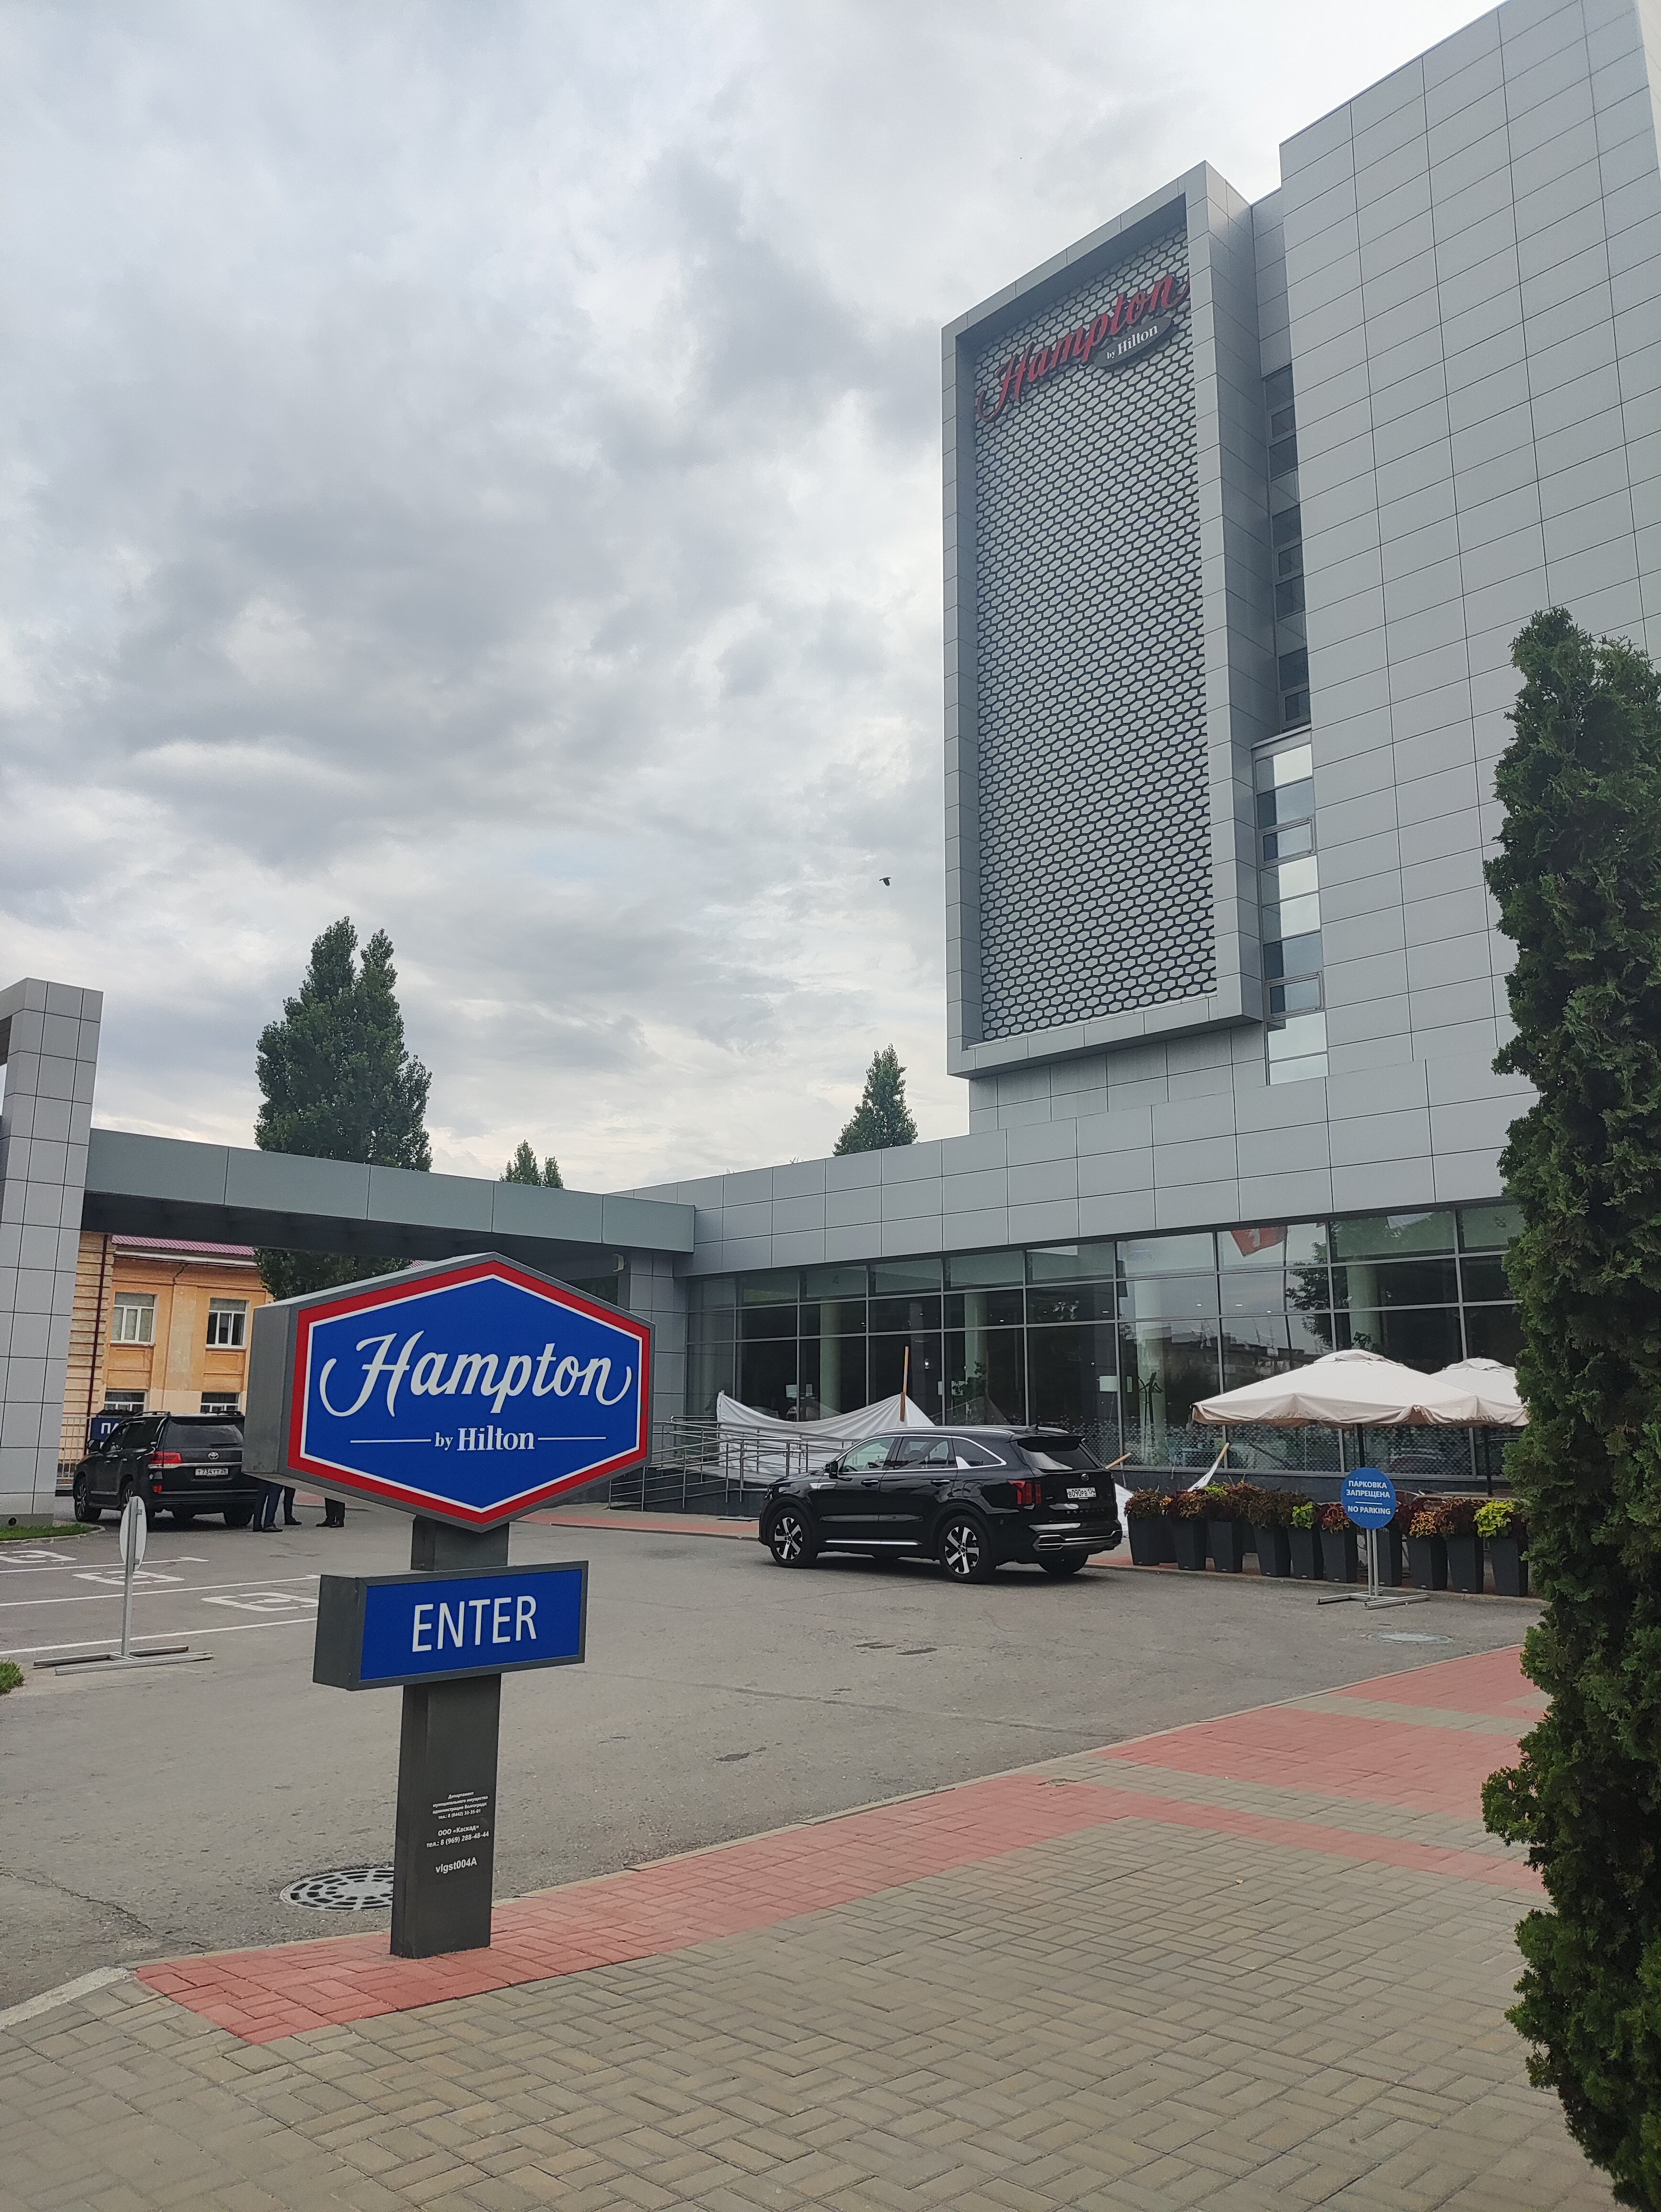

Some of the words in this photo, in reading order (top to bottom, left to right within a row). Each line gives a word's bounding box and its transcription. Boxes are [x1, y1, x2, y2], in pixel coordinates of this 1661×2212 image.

[977, 268, 1190, 423] Hampton
[1106, 351, 1116, 360] by
[1117, 324, 1159, 356] Hilton
[319, 1330, 632, 1417] Hampton
[434, 1431, 454, 1451] by
[456, 1425, 535, 1451] Hilton
[1348, 1480, 1387, 1489] ПАРКОВКА
[1346, 1489, 1390, 1498] ЗАПРЕЩЕНА
[1360, 1506, 1391, 1515] PARKING
[412, 1595, 537, 1652] ENTER
[438, 1828, 452, 1836] ООО
[453, 1825, 479, 1833] «Каскад»
[445, 1836, 460, 1846] (969)
[461, 1831, 489, 1842] 288-48-44
[435, 1857, 477, 1874] vlgst004A
